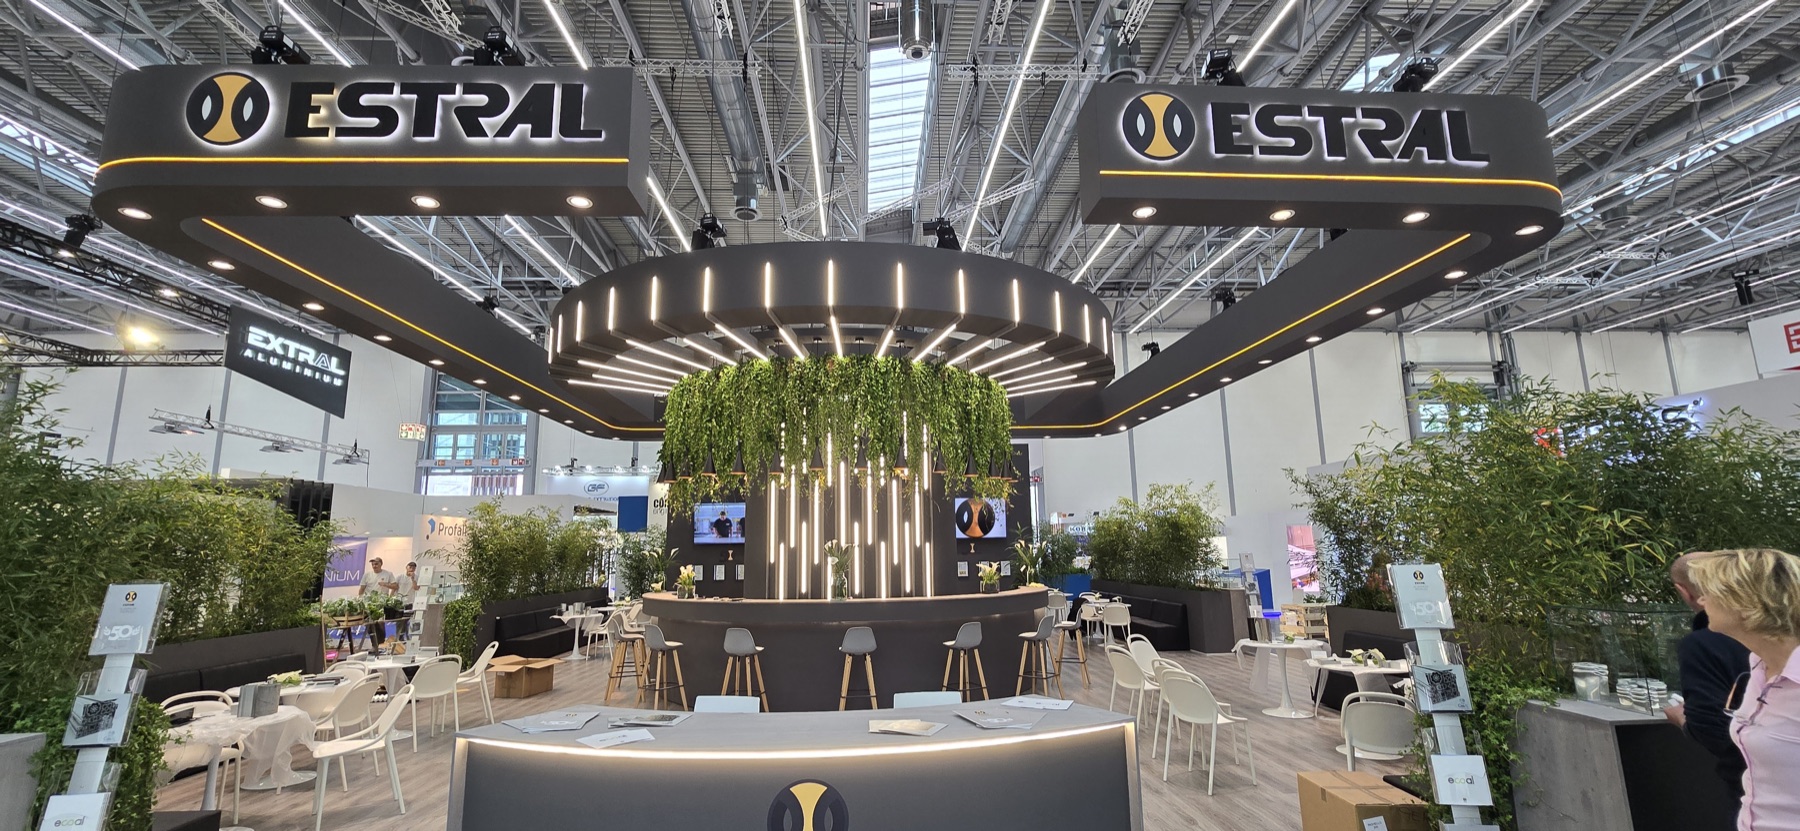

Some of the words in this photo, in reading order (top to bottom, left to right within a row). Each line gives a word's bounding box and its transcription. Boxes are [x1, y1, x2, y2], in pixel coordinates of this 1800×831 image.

[283, 81, 604, 140] ESTRAL
[1209, 101, 1491, 164] ESTRAL
[242, 347, 344, 387] ALUMINIUM
[247, 325, 346, 377] EXTRAL
[1447, 775, 1475, 786] ecoal
[54, 816, 86, 828] ecoal
